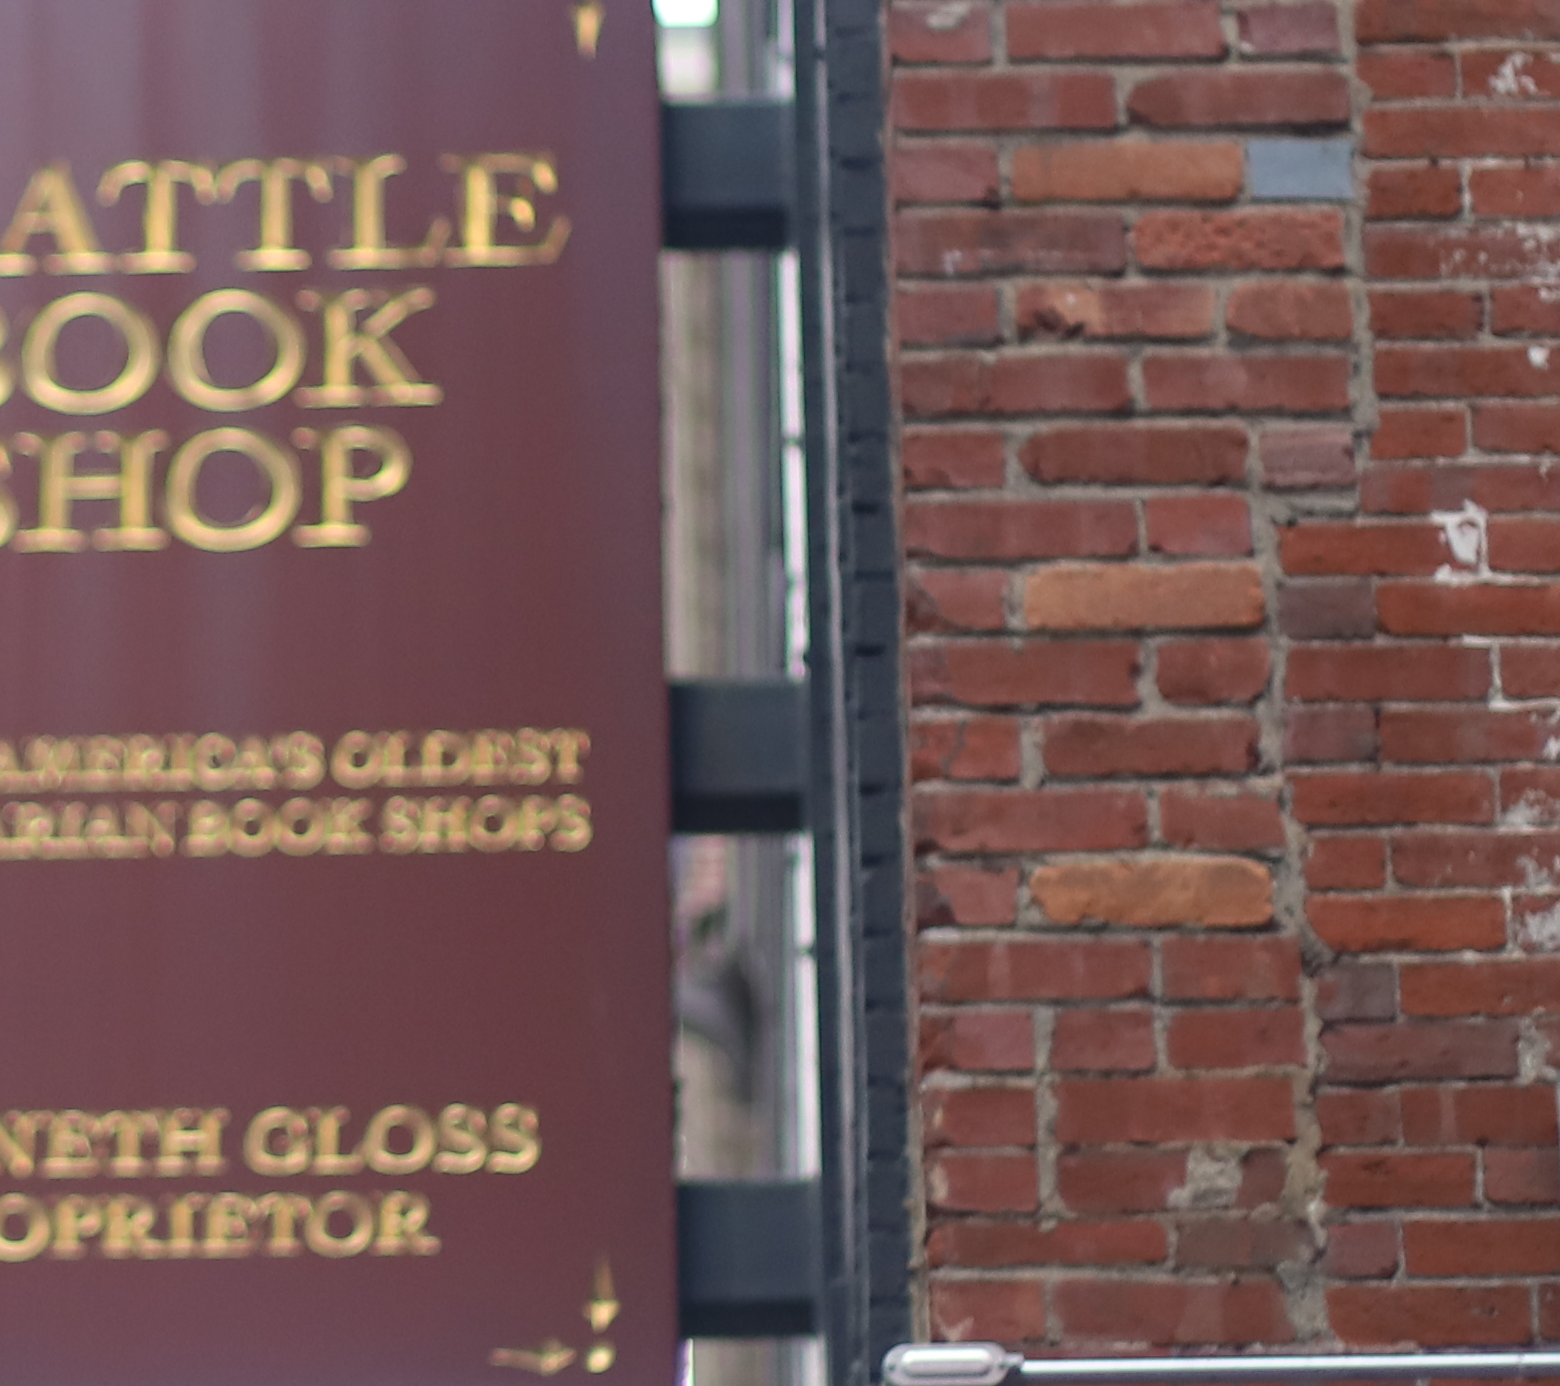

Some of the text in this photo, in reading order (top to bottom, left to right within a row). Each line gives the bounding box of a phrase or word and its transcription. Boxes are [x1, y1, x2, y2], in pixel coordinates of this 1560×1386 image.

[332, 728, 589, 791] OLDEST
[187, 797, 370, 860] BOOK
[386, 795, 593, 855] SHOPS
[243, 1104, 541, 1176] GLOSS
